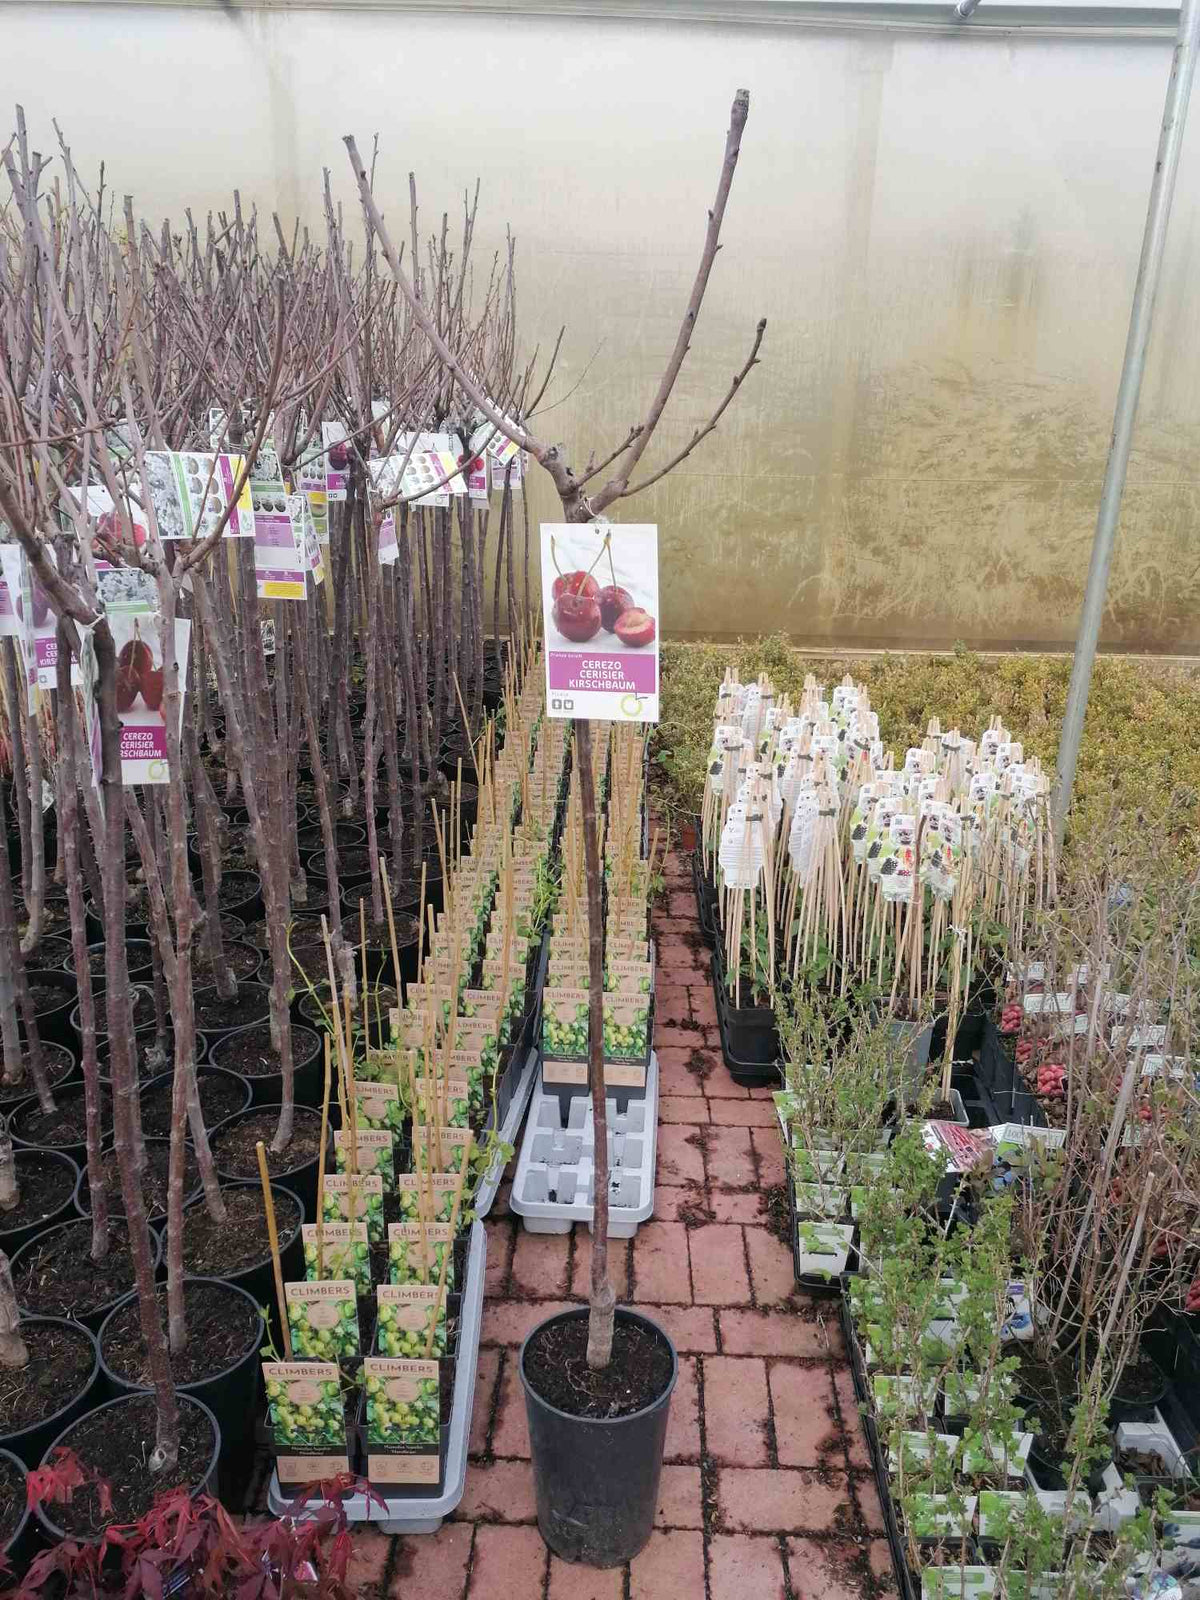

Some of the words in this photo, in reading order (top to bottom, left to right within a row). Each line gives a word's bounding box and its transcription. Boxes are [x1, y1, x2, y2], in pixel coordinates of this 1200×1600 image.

[582, 660, 622, 670] CEREZO
[579, 669, 624, 680] CERISIER
[569, 679, 636, 690] KIRSCHBAUM
[122, 732, 154, 741] CEREZO
[120, 740, 154, 749] CERISIER
[119, 749, 162, 758] RSCHBAUM
[467, 991, 501, 1001] CLIMBER
[546, 992, 586, 1000] CLIMBERS
[457, 1022, 493, 1030] LIMBERS
[355, 1085, 395, 1095] LIMBERS
[338, 1134, 389, 1143] CBERS
[403, 1178, 456, 1187] CLMBERS
[306, 1229, 363, 1238] CLIMBES
[290, 1286, 351, 1297] CLIMBERS
[268, 1367, 333, 1377] CLIMBERS
[370, 1362, 434, 1374] CLIMBERS
